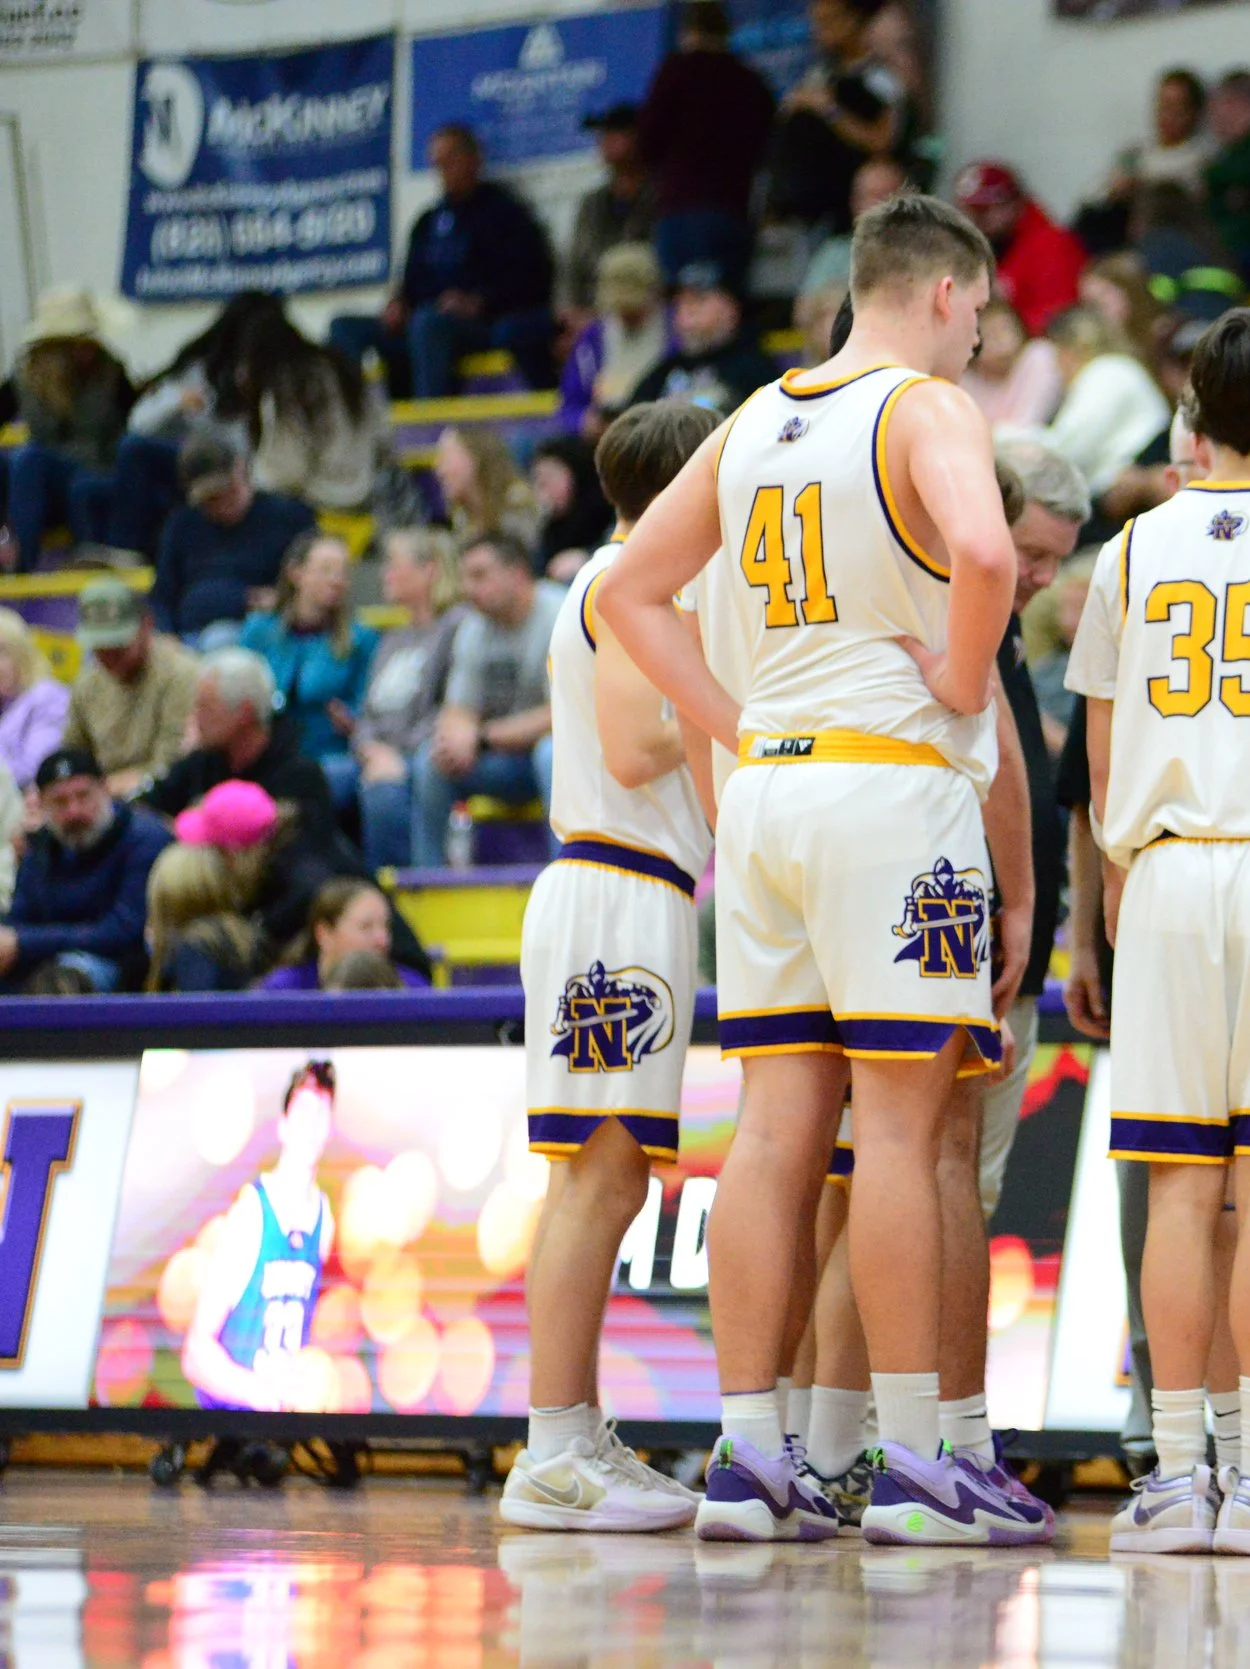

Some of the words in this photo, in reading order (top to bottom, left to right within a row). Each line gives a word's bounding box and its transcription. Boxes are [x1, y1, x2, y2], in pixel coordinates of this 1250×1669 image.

[740, 481, 839, 629] 41
[918, 896, 977, 979] N
[568, 996, 634, 1073] N
